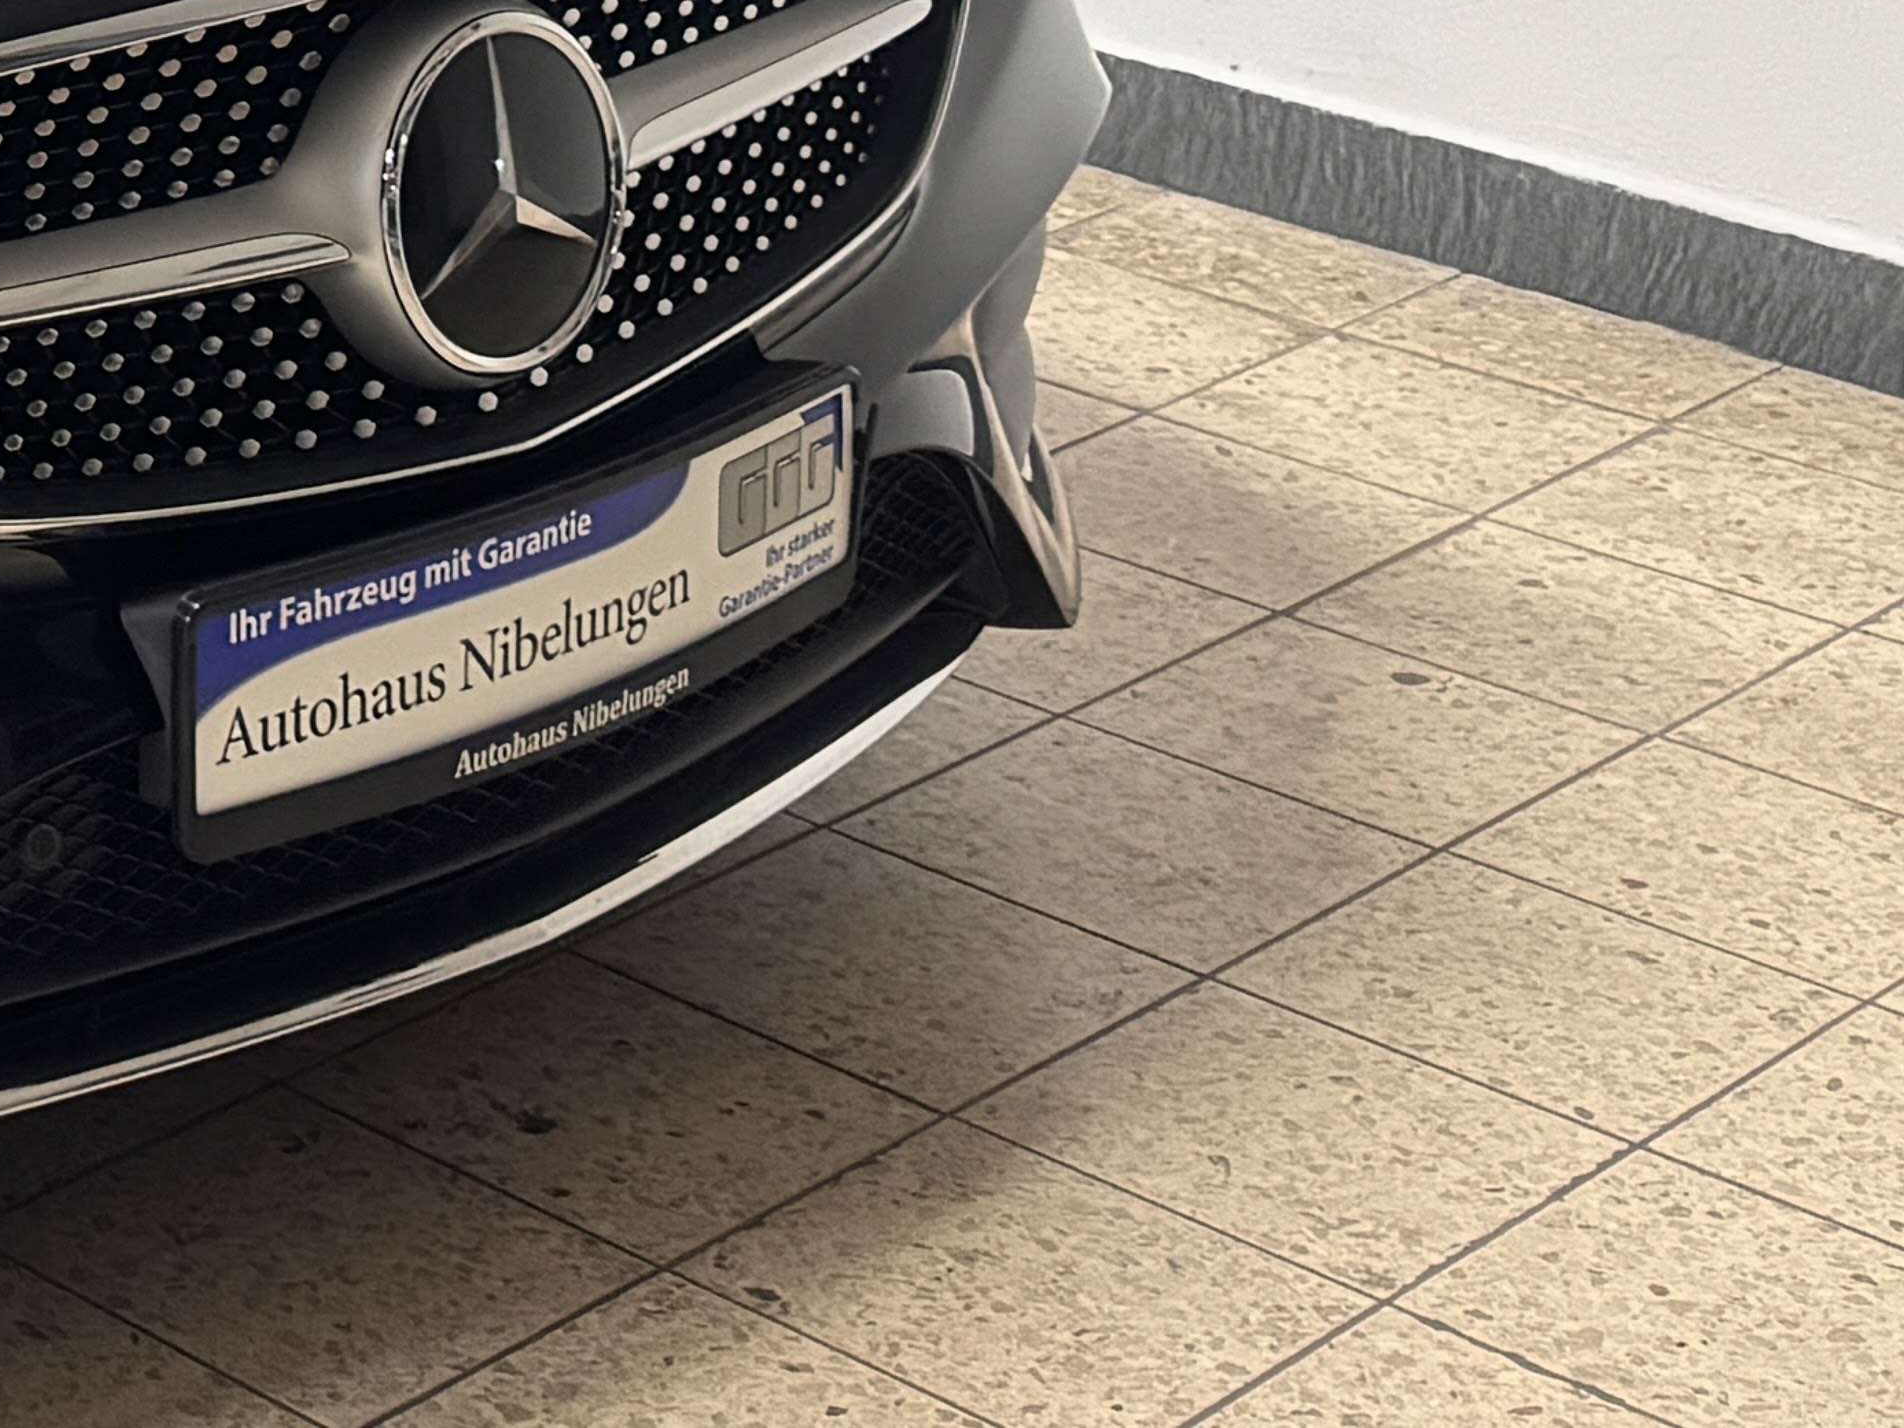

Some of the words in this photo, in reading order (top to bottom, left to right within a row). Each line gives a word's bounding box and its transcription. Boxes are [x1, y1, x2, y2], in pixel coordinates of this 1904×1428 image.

[229, 608, 273, 644] Ihr
[279, 568, 418, 631] Fahrzeug
[423, 547, 473, 590] mit
[477, 508, 593, 571] Garantie
[215, 662, 447, 766] Autohaus
[460, 569, 690, 693] Nibelungen
[454, 721, 568, 780] Autohaus
[572, 667, 690, 738] Nibelungen
